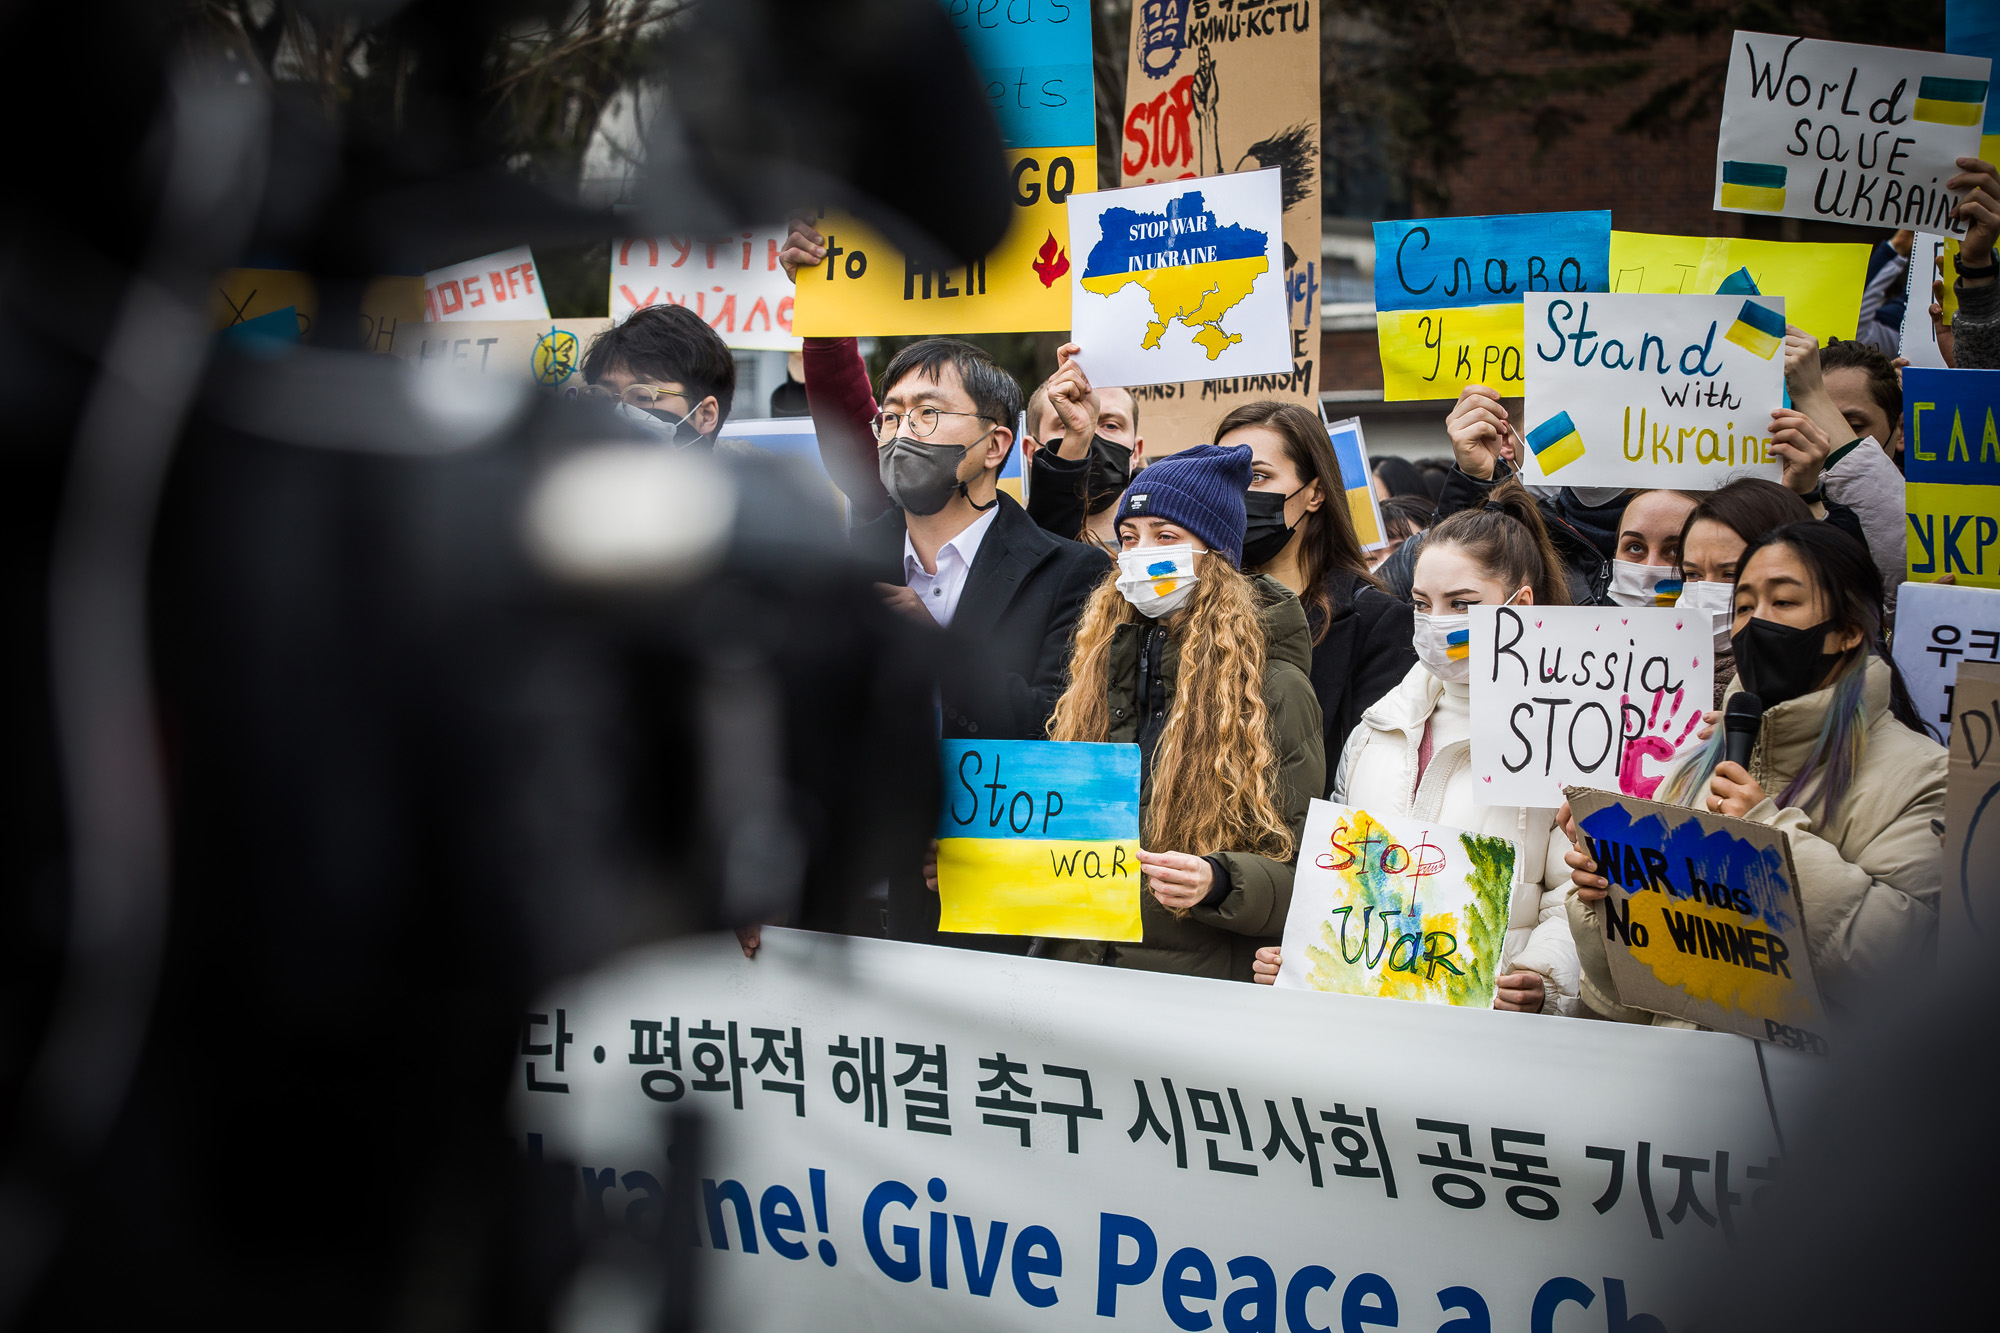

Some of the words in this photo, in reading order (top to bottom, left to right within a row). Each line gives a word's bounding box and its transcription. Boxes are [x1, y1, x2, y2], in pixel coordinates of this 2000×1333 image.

[1123, 75, 1195, 177] STOP
[1012, 156, 1075, 207] GO
[826, 236, 867, 280] to
[1128, 255, 1145, 272] IN
[1147, 245, 1218, 270] UKRAINE
[1129, 221, 1169, 241] STOP
[1171, 215, 1208, 235] WAR
[1395, 227, 1588, 298] Слава
[1537, 299, 1724, 377] Stand
[1906, 512, 2000, 576] УКР
[1491, 607, 1685, 695] Russia
[1502, 697, 1647, 777] STOP
[1584, 836, 1678, 897] WAR
[1685, 857, 1753, 915] has
[1661, 907, 1792, 979] WINNER
[828, 1035, 952, 1136] 해결
[975, 1052, 1104, 1154] 촉구
[1127, 1076, 1398, 1200] 시민사회
[1416, 1117, 1562, 1221] 공동
[862, 1177, 1063, 1309] Give
[1096, 1213, 1400, 1333] Peace
[1436, 1285, 1492, 1333] a
